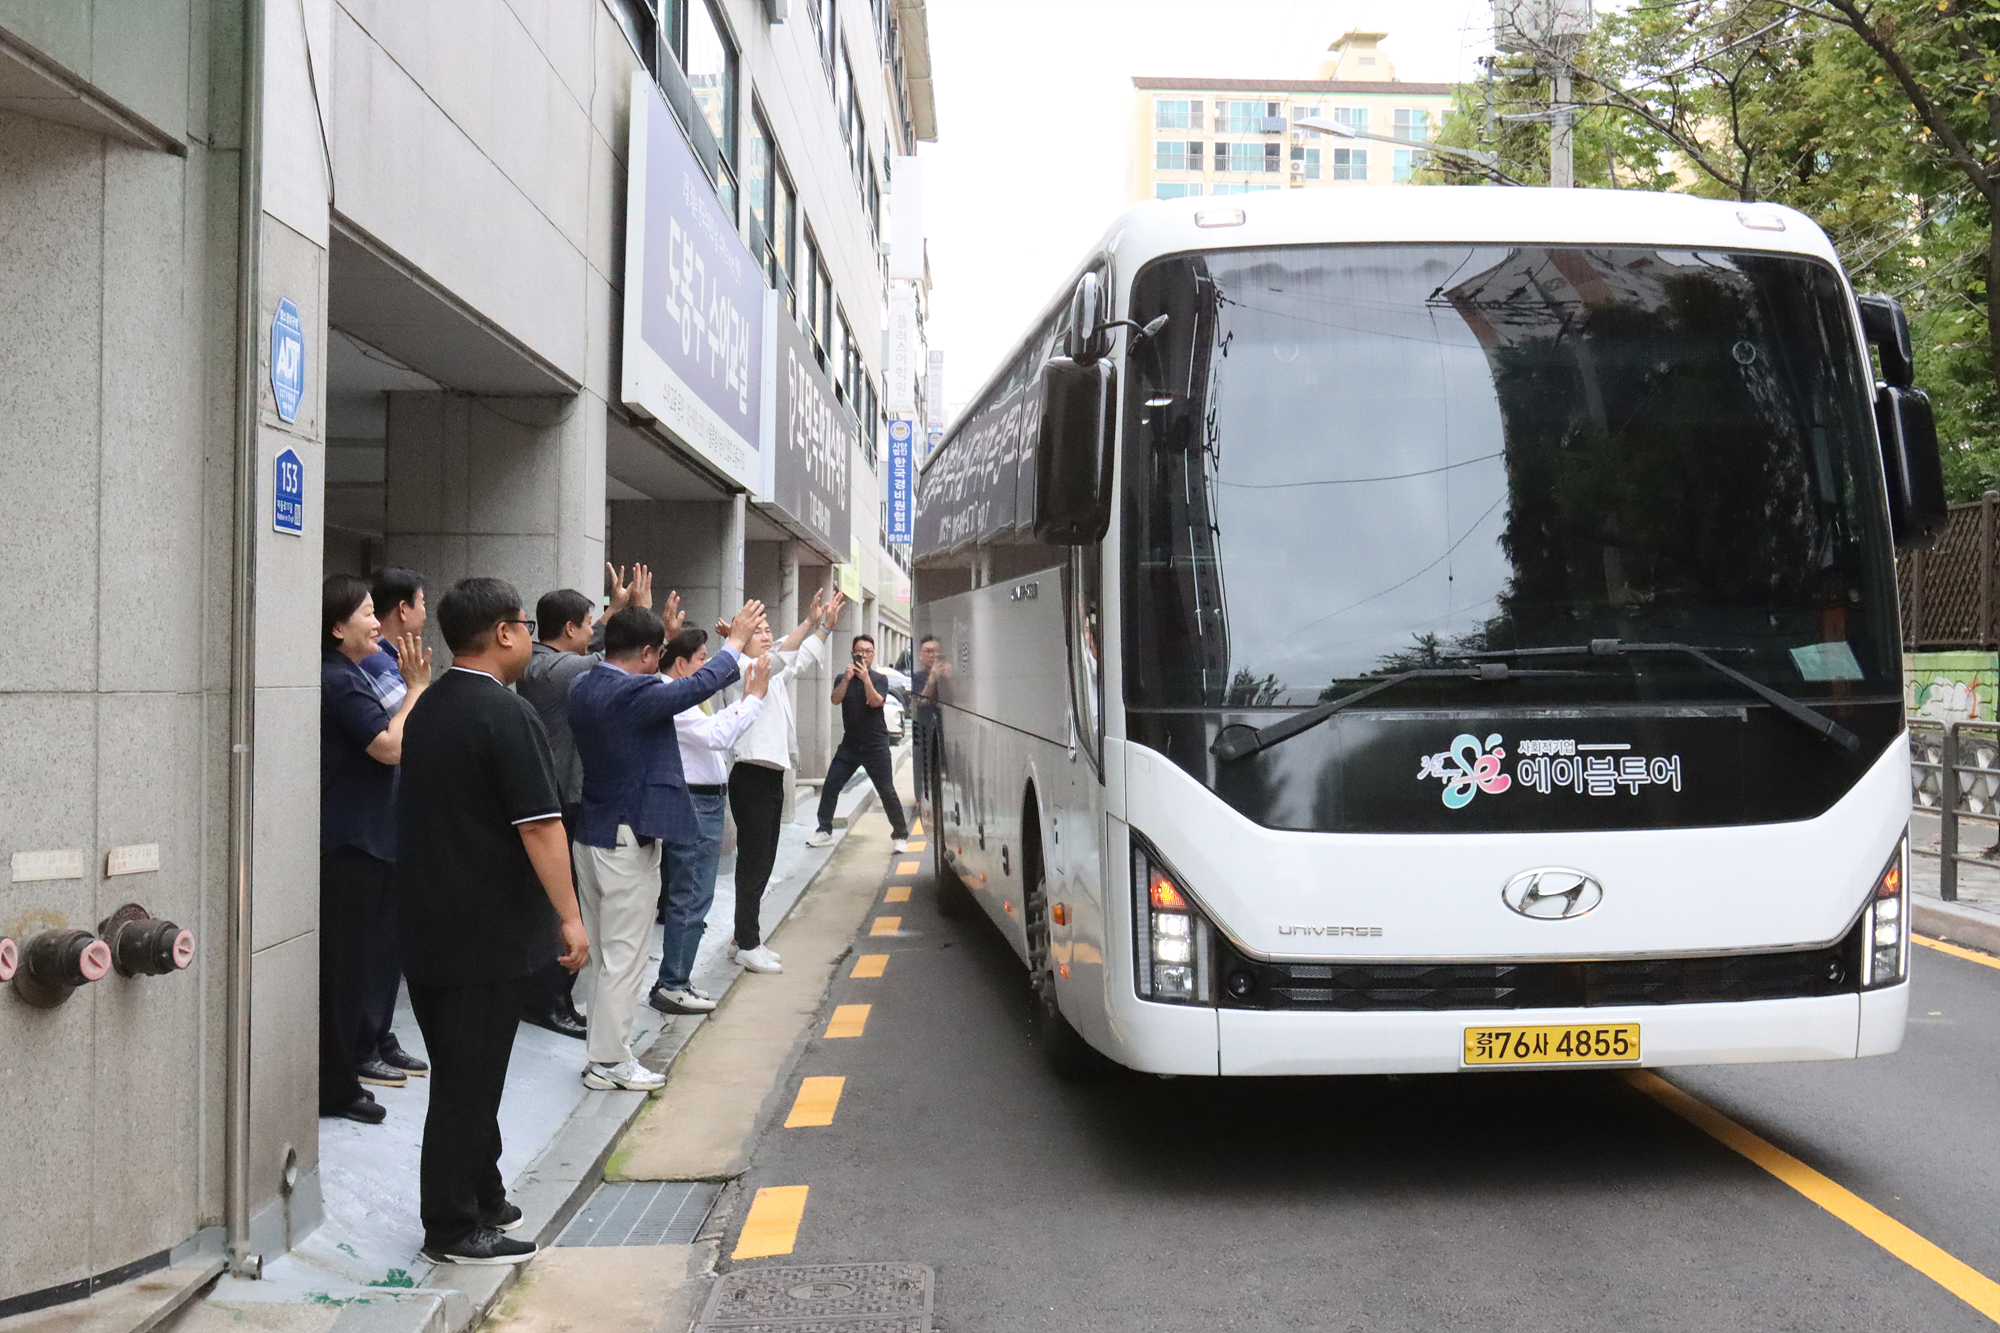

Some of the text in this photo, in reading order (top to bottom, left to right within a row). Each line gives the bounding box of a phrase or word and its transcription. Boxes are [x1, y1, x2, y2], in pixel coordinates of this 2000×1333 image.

[665, 214, 706, 362] 도봉구
[707, 276, 748, 416] 수어교실
[276, 336, 300, 383] ADT
[895, 315, 908, 396] 플러스어학원
[281, 461, 298, 494] 153
[893, 457, 906, 533] 한국경비원협회
[888, 533, 911, 543] 중앙회
[1518, 739, 1576, 756] 사회적기업
[1517, 755, 1682, 796] 에이블투어
[1278, 924, 1383, 937] UNIVERSE
[1475, 1028, 1630, 1059] 경기76사 4855
